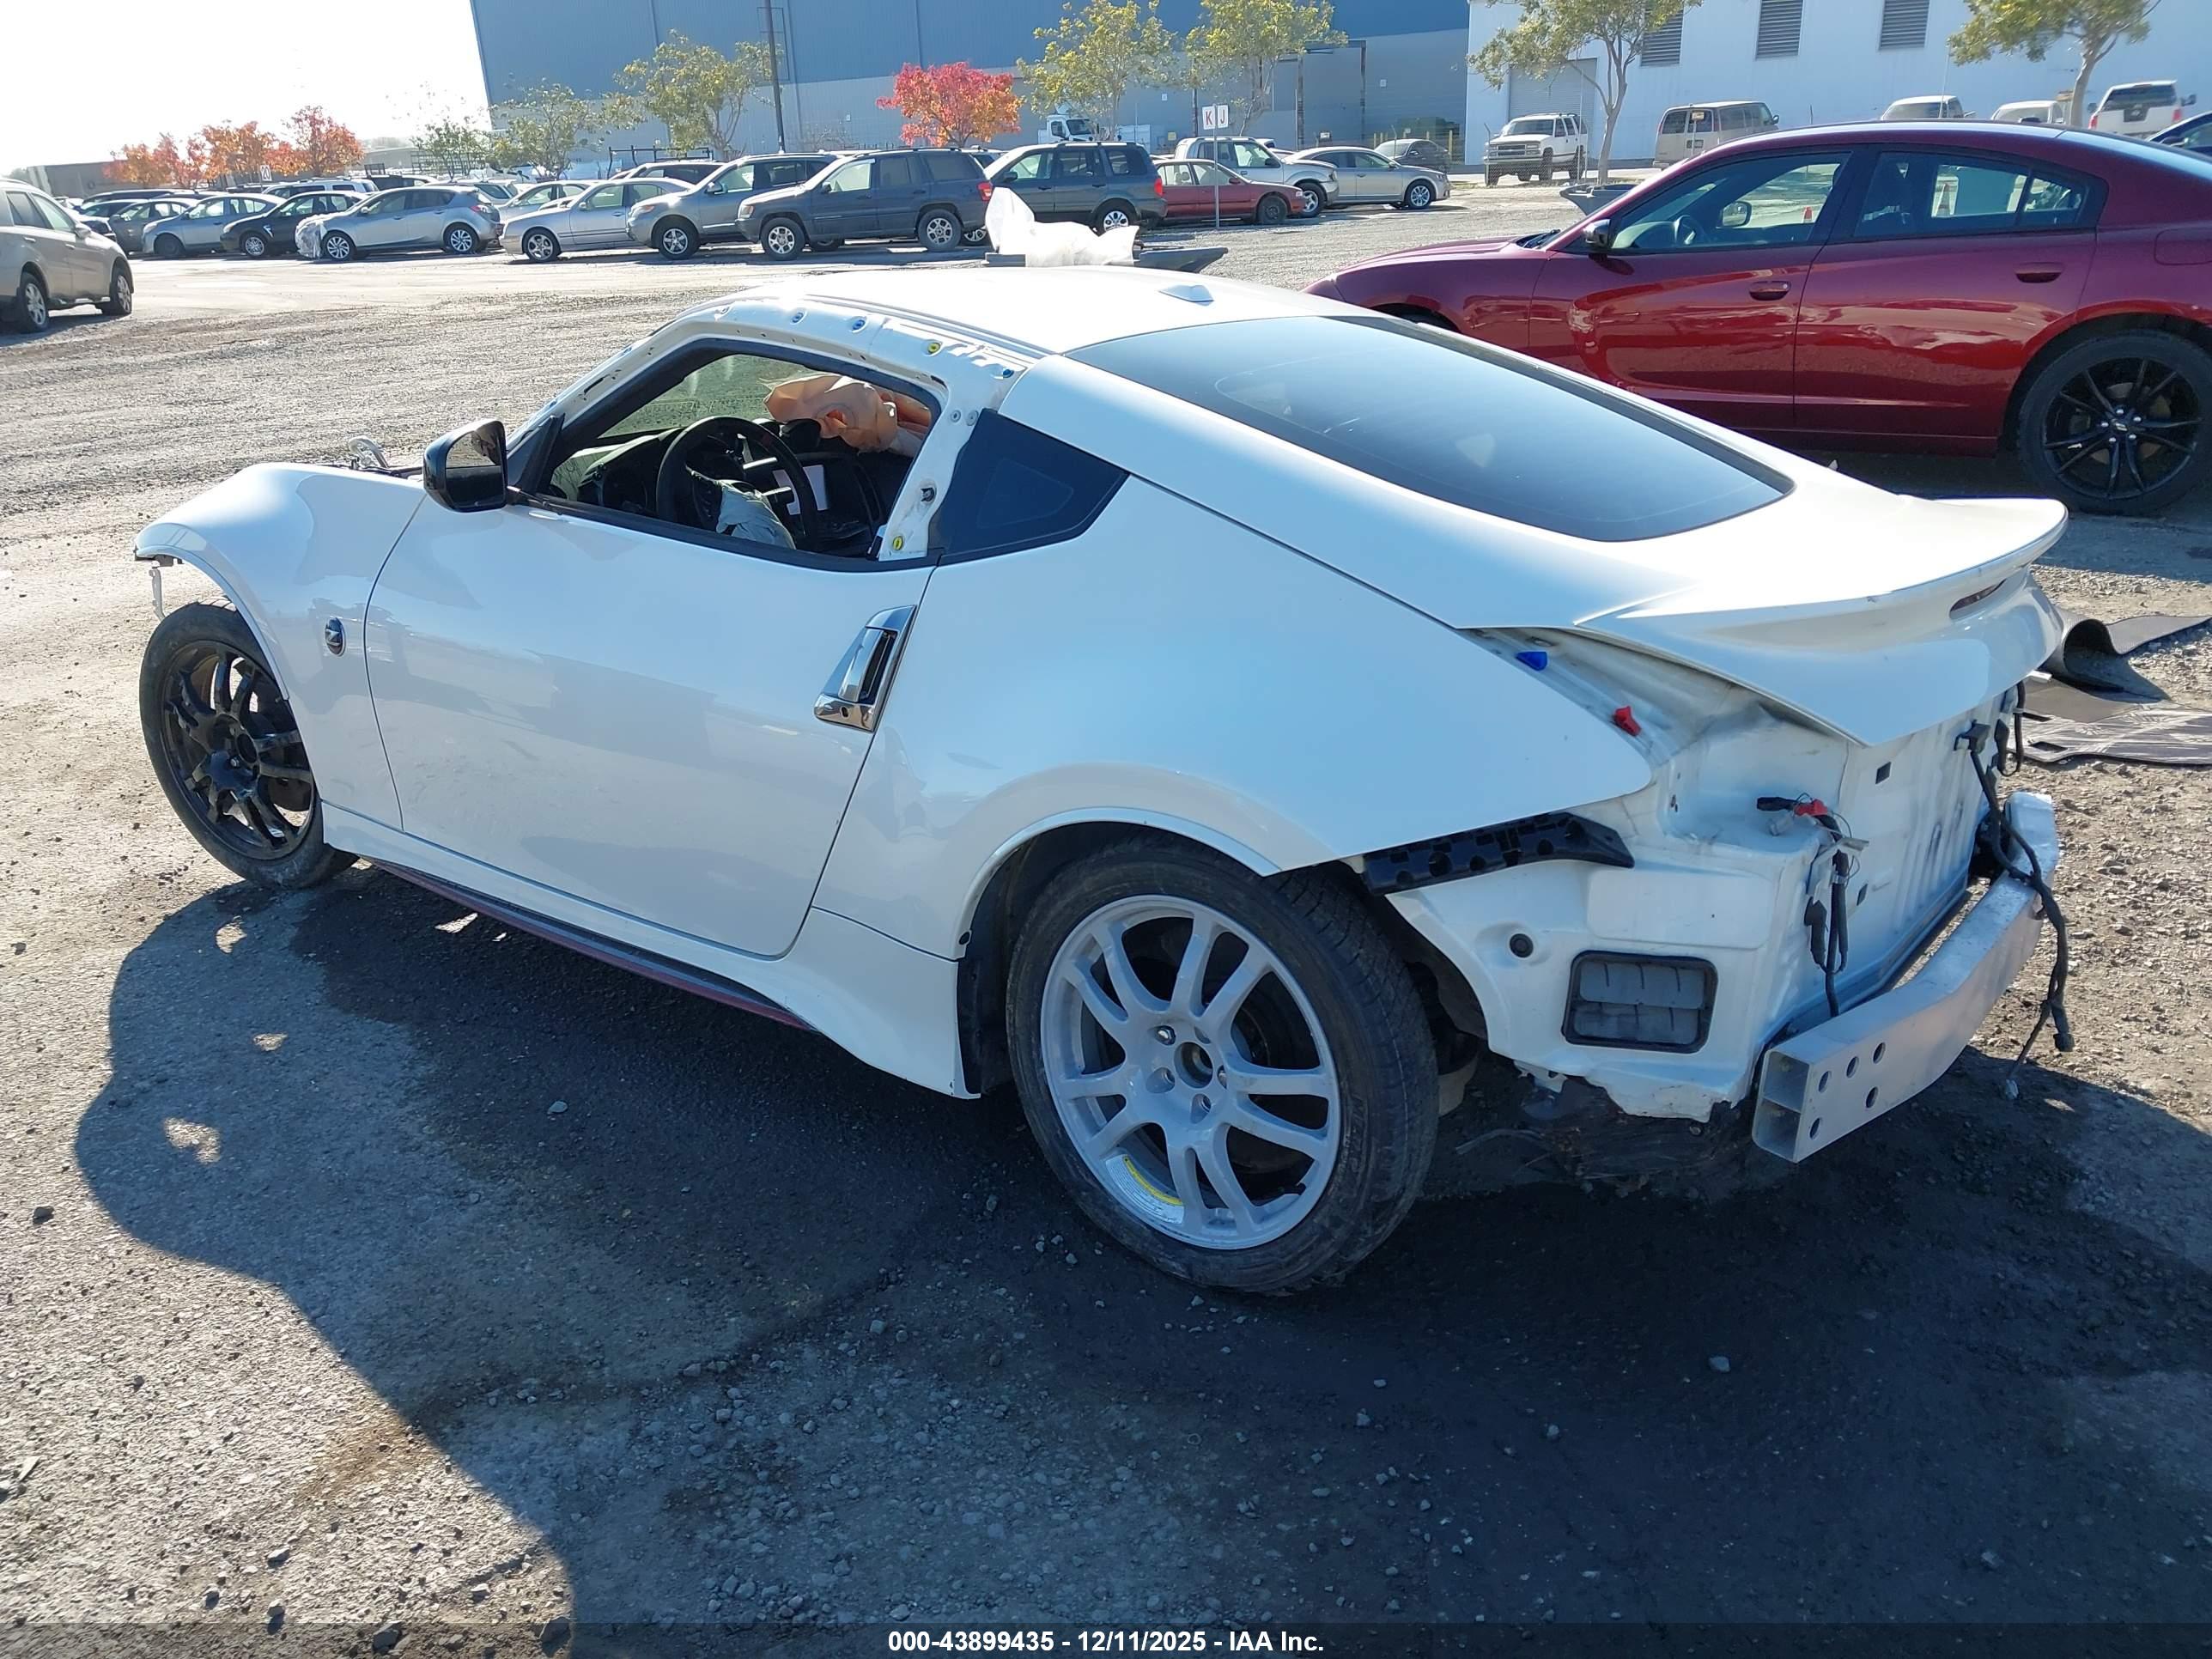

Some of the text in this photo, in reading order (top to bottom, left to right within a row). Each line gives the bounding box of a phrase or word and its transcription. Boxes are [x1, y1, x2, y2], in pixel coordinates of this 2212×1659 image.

[1206, 110, 1213, 125] K
[1219, 109, 1225, 125] J
[261, 166, 270, 179] 20
